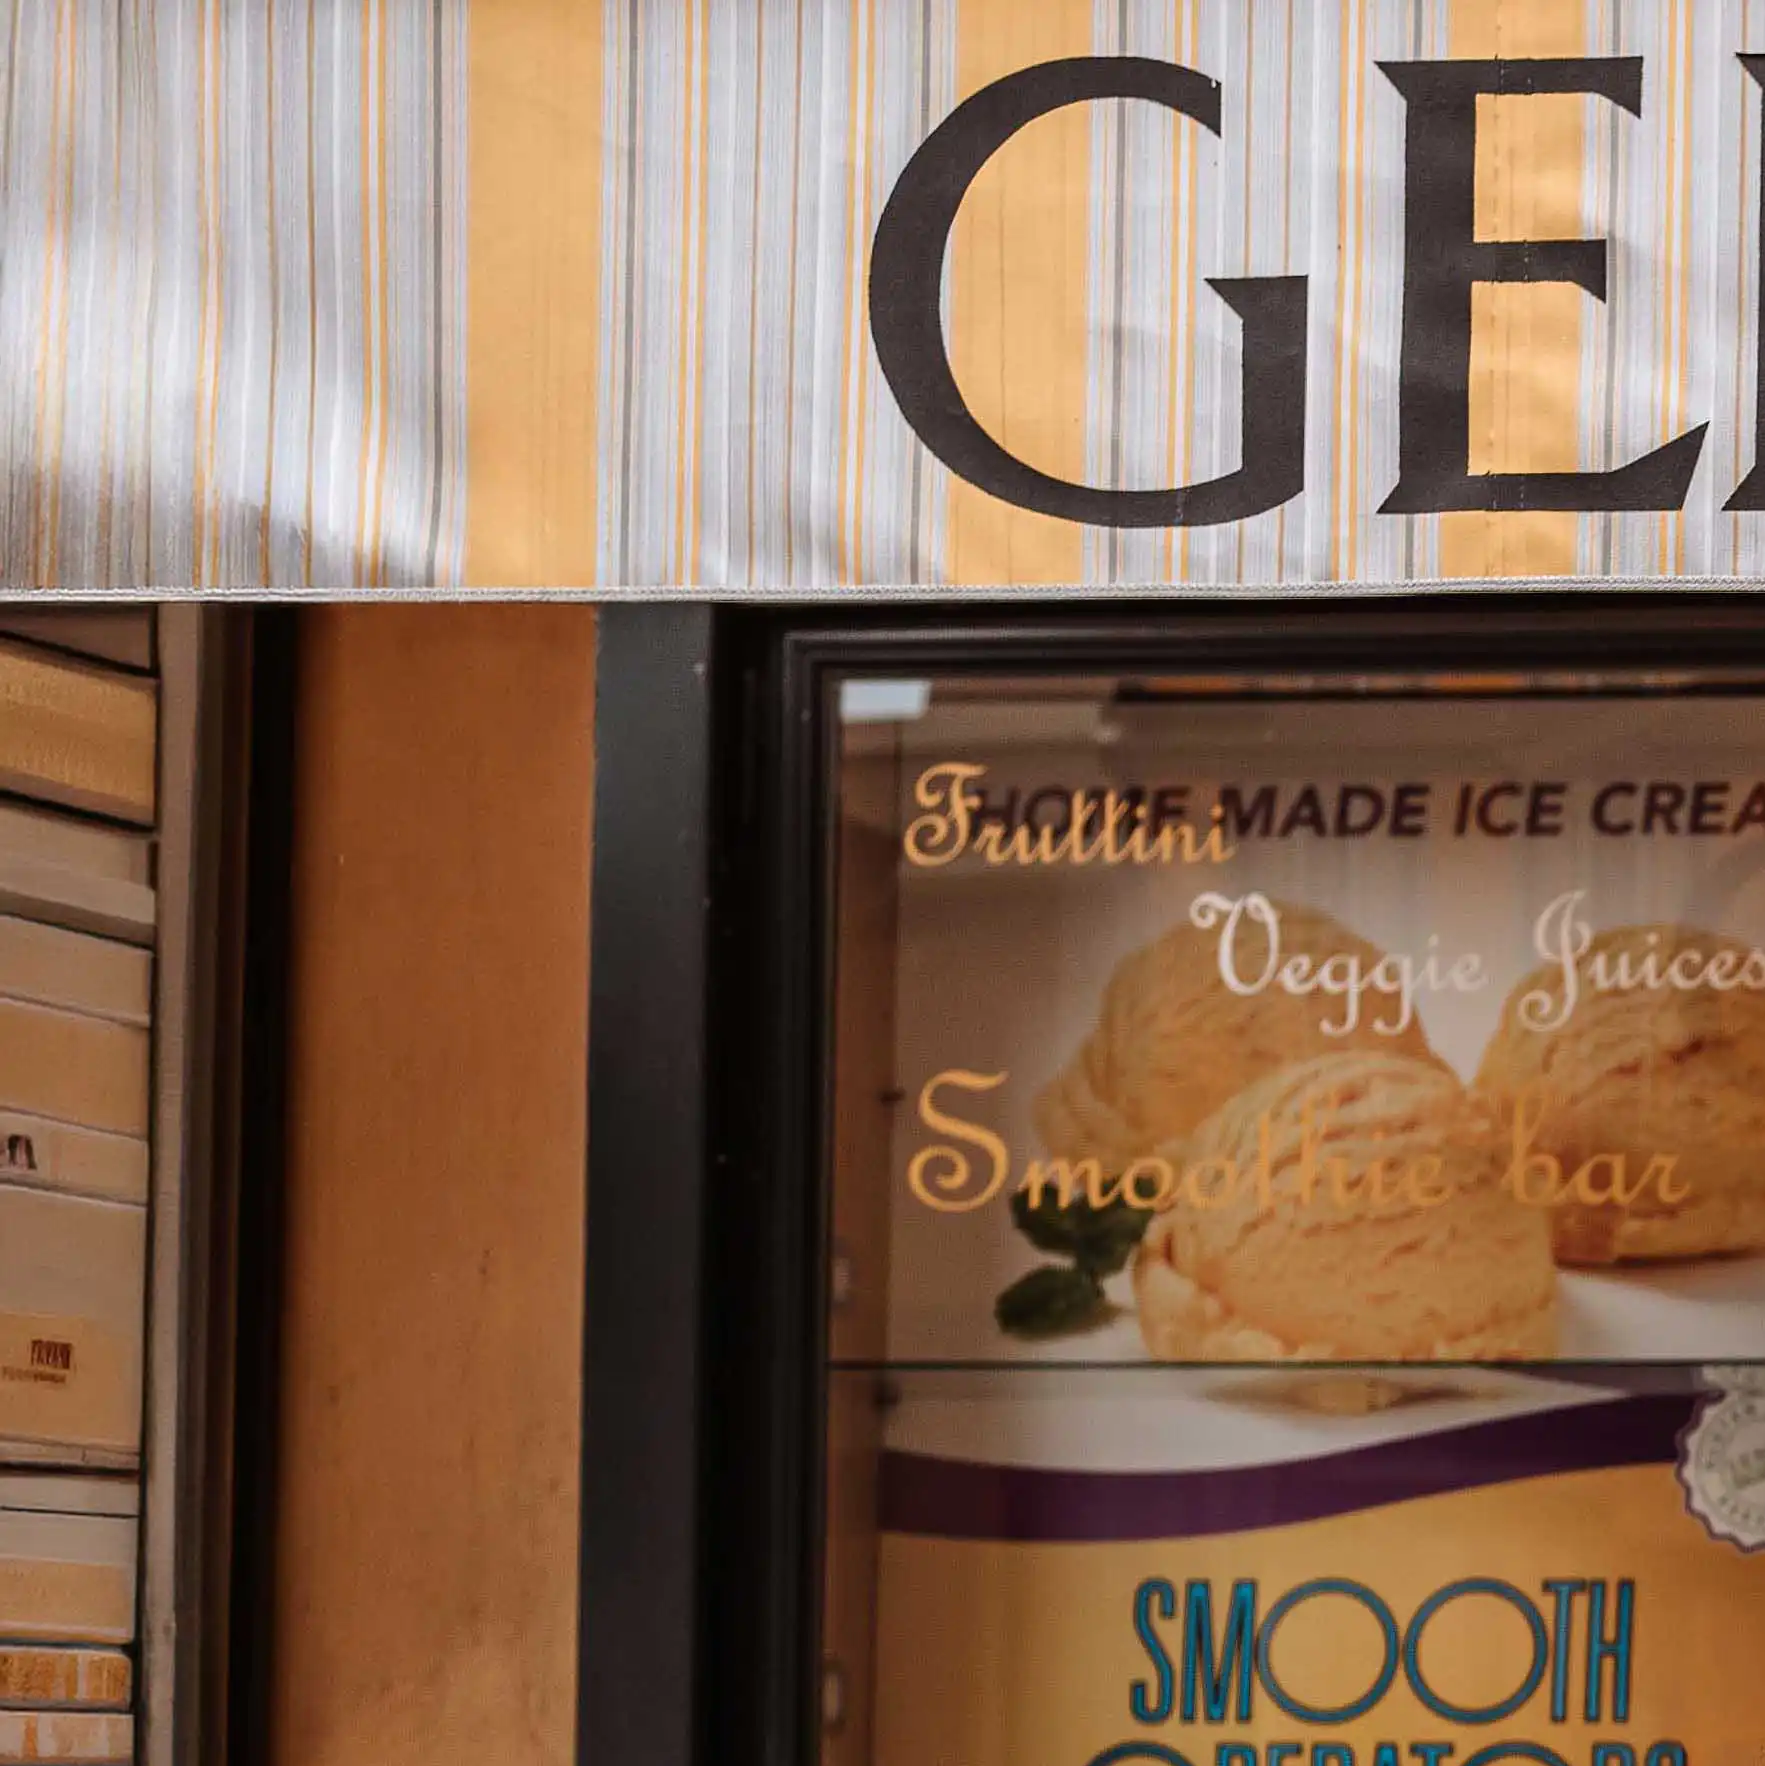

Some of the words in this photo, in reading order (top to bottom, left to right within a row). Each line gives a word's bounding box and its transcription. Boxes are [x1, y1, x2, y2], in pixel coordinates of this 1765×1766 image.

[1221, 781, 1431, 838] MADE
[1454, 780, 1568, 837] ICE
[1188, 890, 1490, 1037] Veggie
[905, 1066, 1452, 1213] Smoothie
[1502, 1086, 1695, 1206] bar
[1129, 1577, 1636, 1725] SMOOTH
